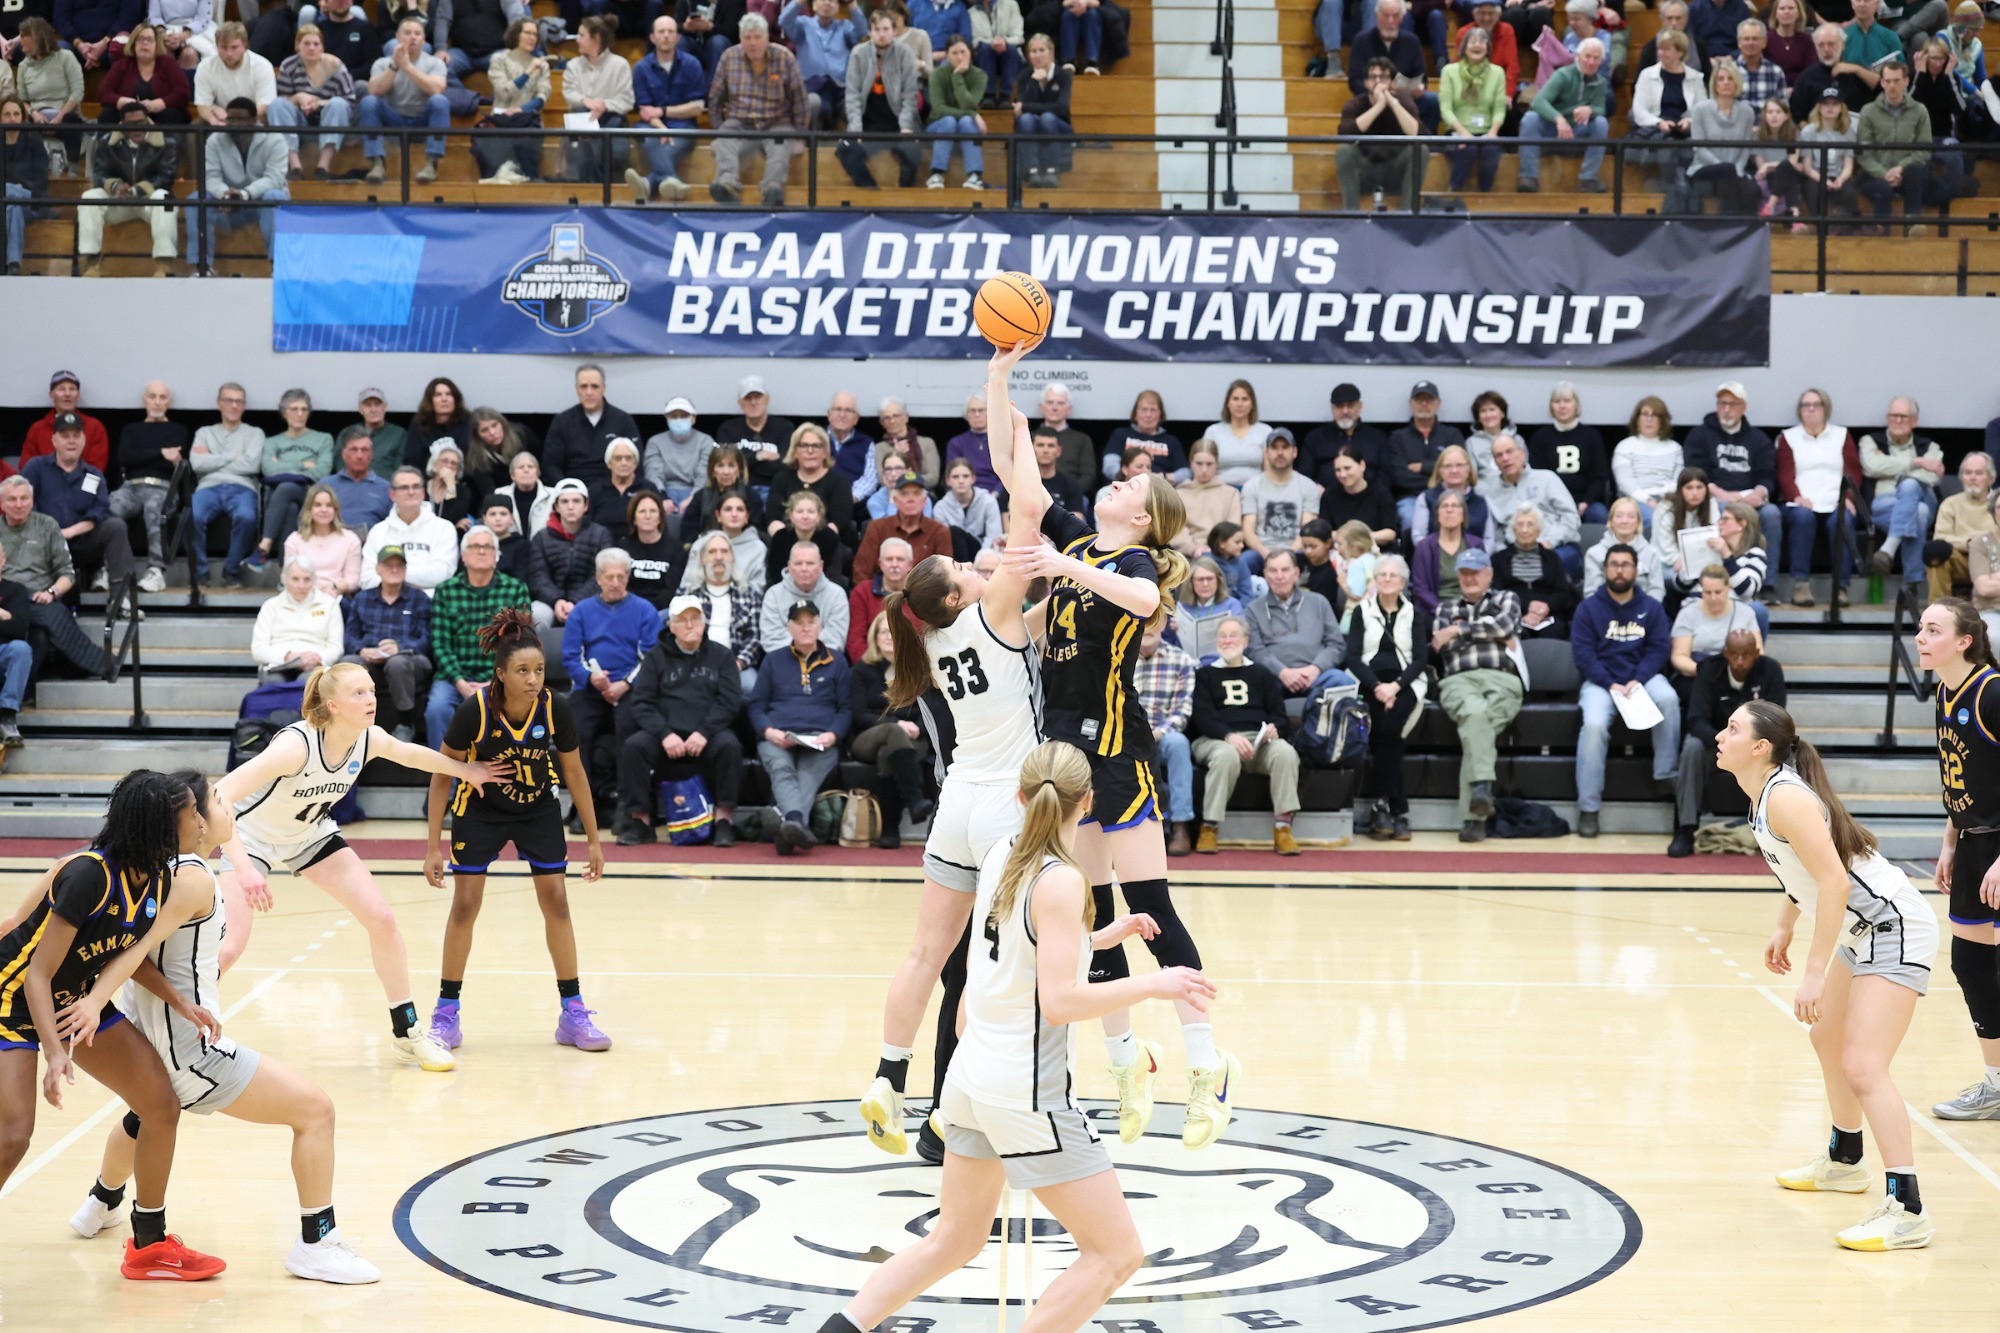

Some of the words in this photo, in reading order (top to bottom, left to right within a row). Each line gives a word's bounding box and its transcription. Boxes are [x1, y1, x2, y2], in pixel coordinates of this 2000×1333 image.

[534, 264, 569, 274] 2026
[571, 264, 598, 274] DIII
[667, 231, 845, 279] NCAA
[861, 232, 1011, 280] DIII
[1030, 234, 1339, 285] WOMEN'S
[505, 281, 626, 301] CHAMPIONSHIP
[561, 273, 611, 283] BASKETBALL
[666, 285, 1083, 338] BASKETBL
[1104, 290, 1645, 344] CHAMPIONSHIP
[1012, 370, 1029, 380] NO
[1033, 370, 1088, 381] CLIMBING
[1556, 445, 1580, 474] B
[1049, 596, 1077, 640] 14
[938, 647, 990, 701] 33
[1221, 679, 1249, 706] B
[513, 760, 536, 787] 11
[1941, 750, 1965, 790] 32
